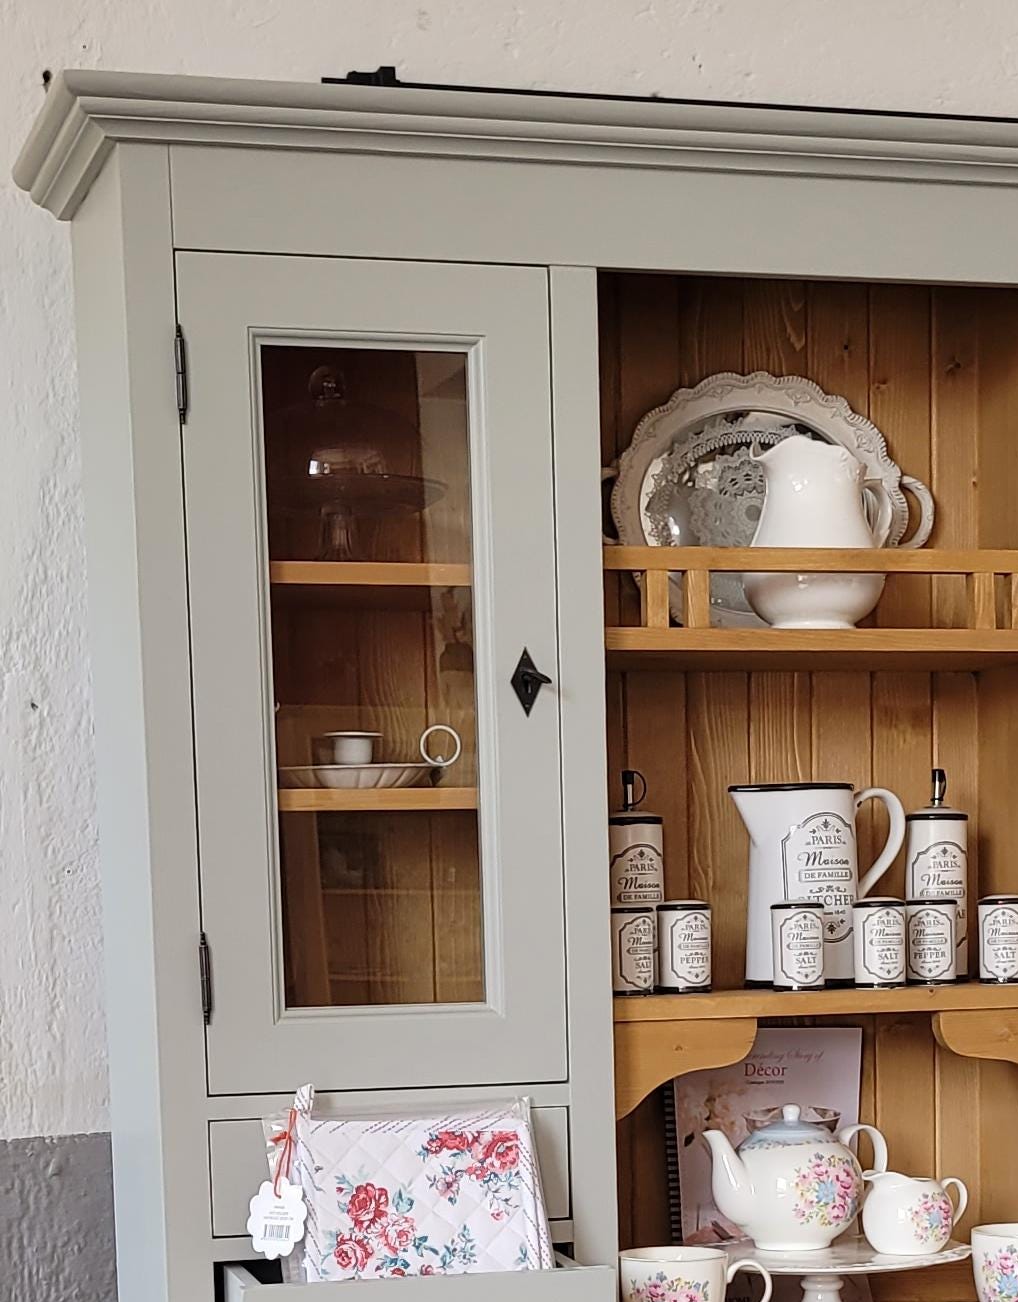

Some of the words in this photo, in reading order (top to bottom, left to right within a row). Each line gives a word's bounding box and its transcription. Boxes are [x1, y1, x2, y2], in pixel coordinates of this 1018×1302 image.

[811, 835, 842, 845] PARIS
[797, 851, 849, 866] Maison
[933, 860, 958, 868] PARIS
[817, 871, 849, 879] FAMILLE
[618, 877, 660, 889] Maison
[878, 952, 899, 960] SALT
[994, 951, 1016, 959] SALT
[795, 956, 816, 964] SALT
[744, 1062, 788, 1077] Décor
